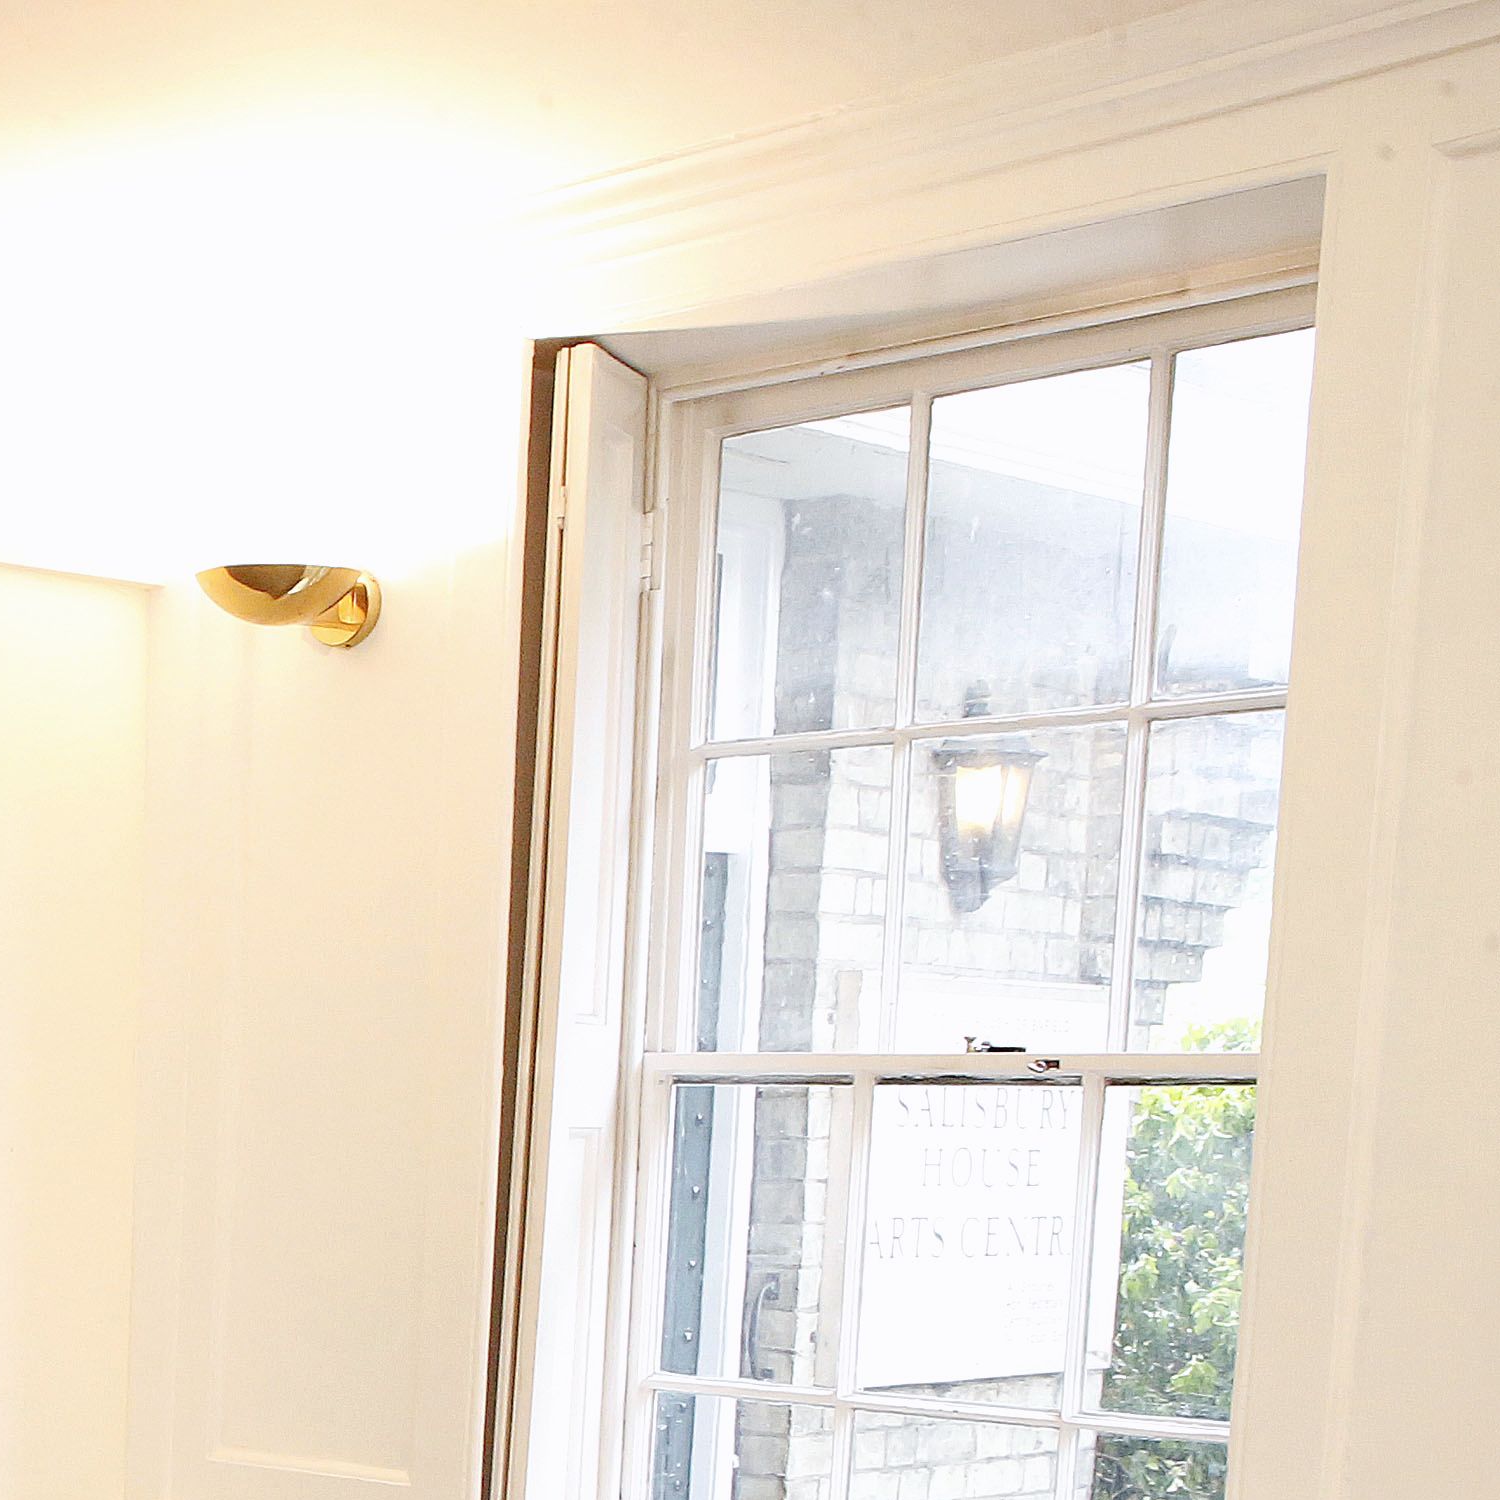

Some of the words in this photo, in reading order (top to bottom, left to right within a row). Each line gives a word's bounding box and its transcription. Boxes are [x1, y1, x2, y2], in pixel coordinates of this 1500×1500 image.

[896, 1086, 1075, 1130] SALISBURY
[922, 1146, 1041, 1188] HOUSE
[869, 1216, 945, 1259] ARTS
[960, 1215, 1071, 1258] CENTR
